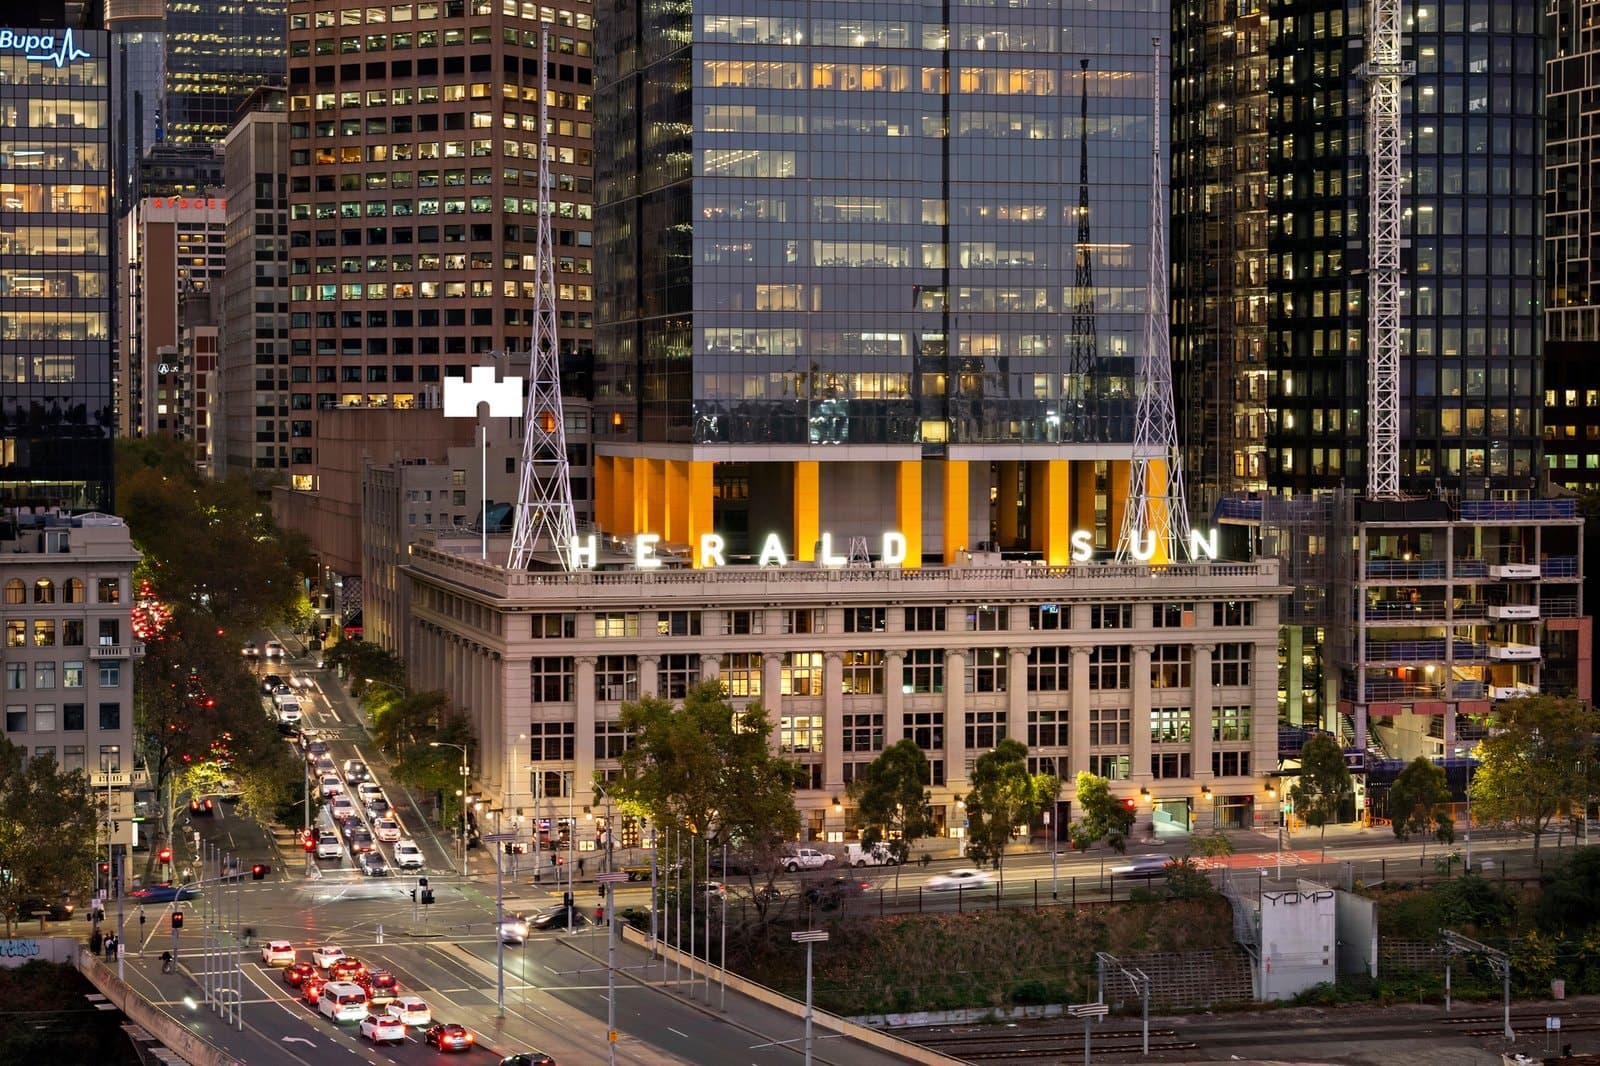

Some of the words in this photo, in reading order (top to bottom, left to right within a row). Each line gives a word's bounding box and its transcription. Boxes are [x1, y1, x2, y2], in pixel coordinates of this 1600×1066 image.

[0, 30, 55, 52] Bupa
[571, 532, 906, 568] HERALD
[1071, 528, 1218, 562] SUN
[1263, 890, 1334, 906] YOMP
